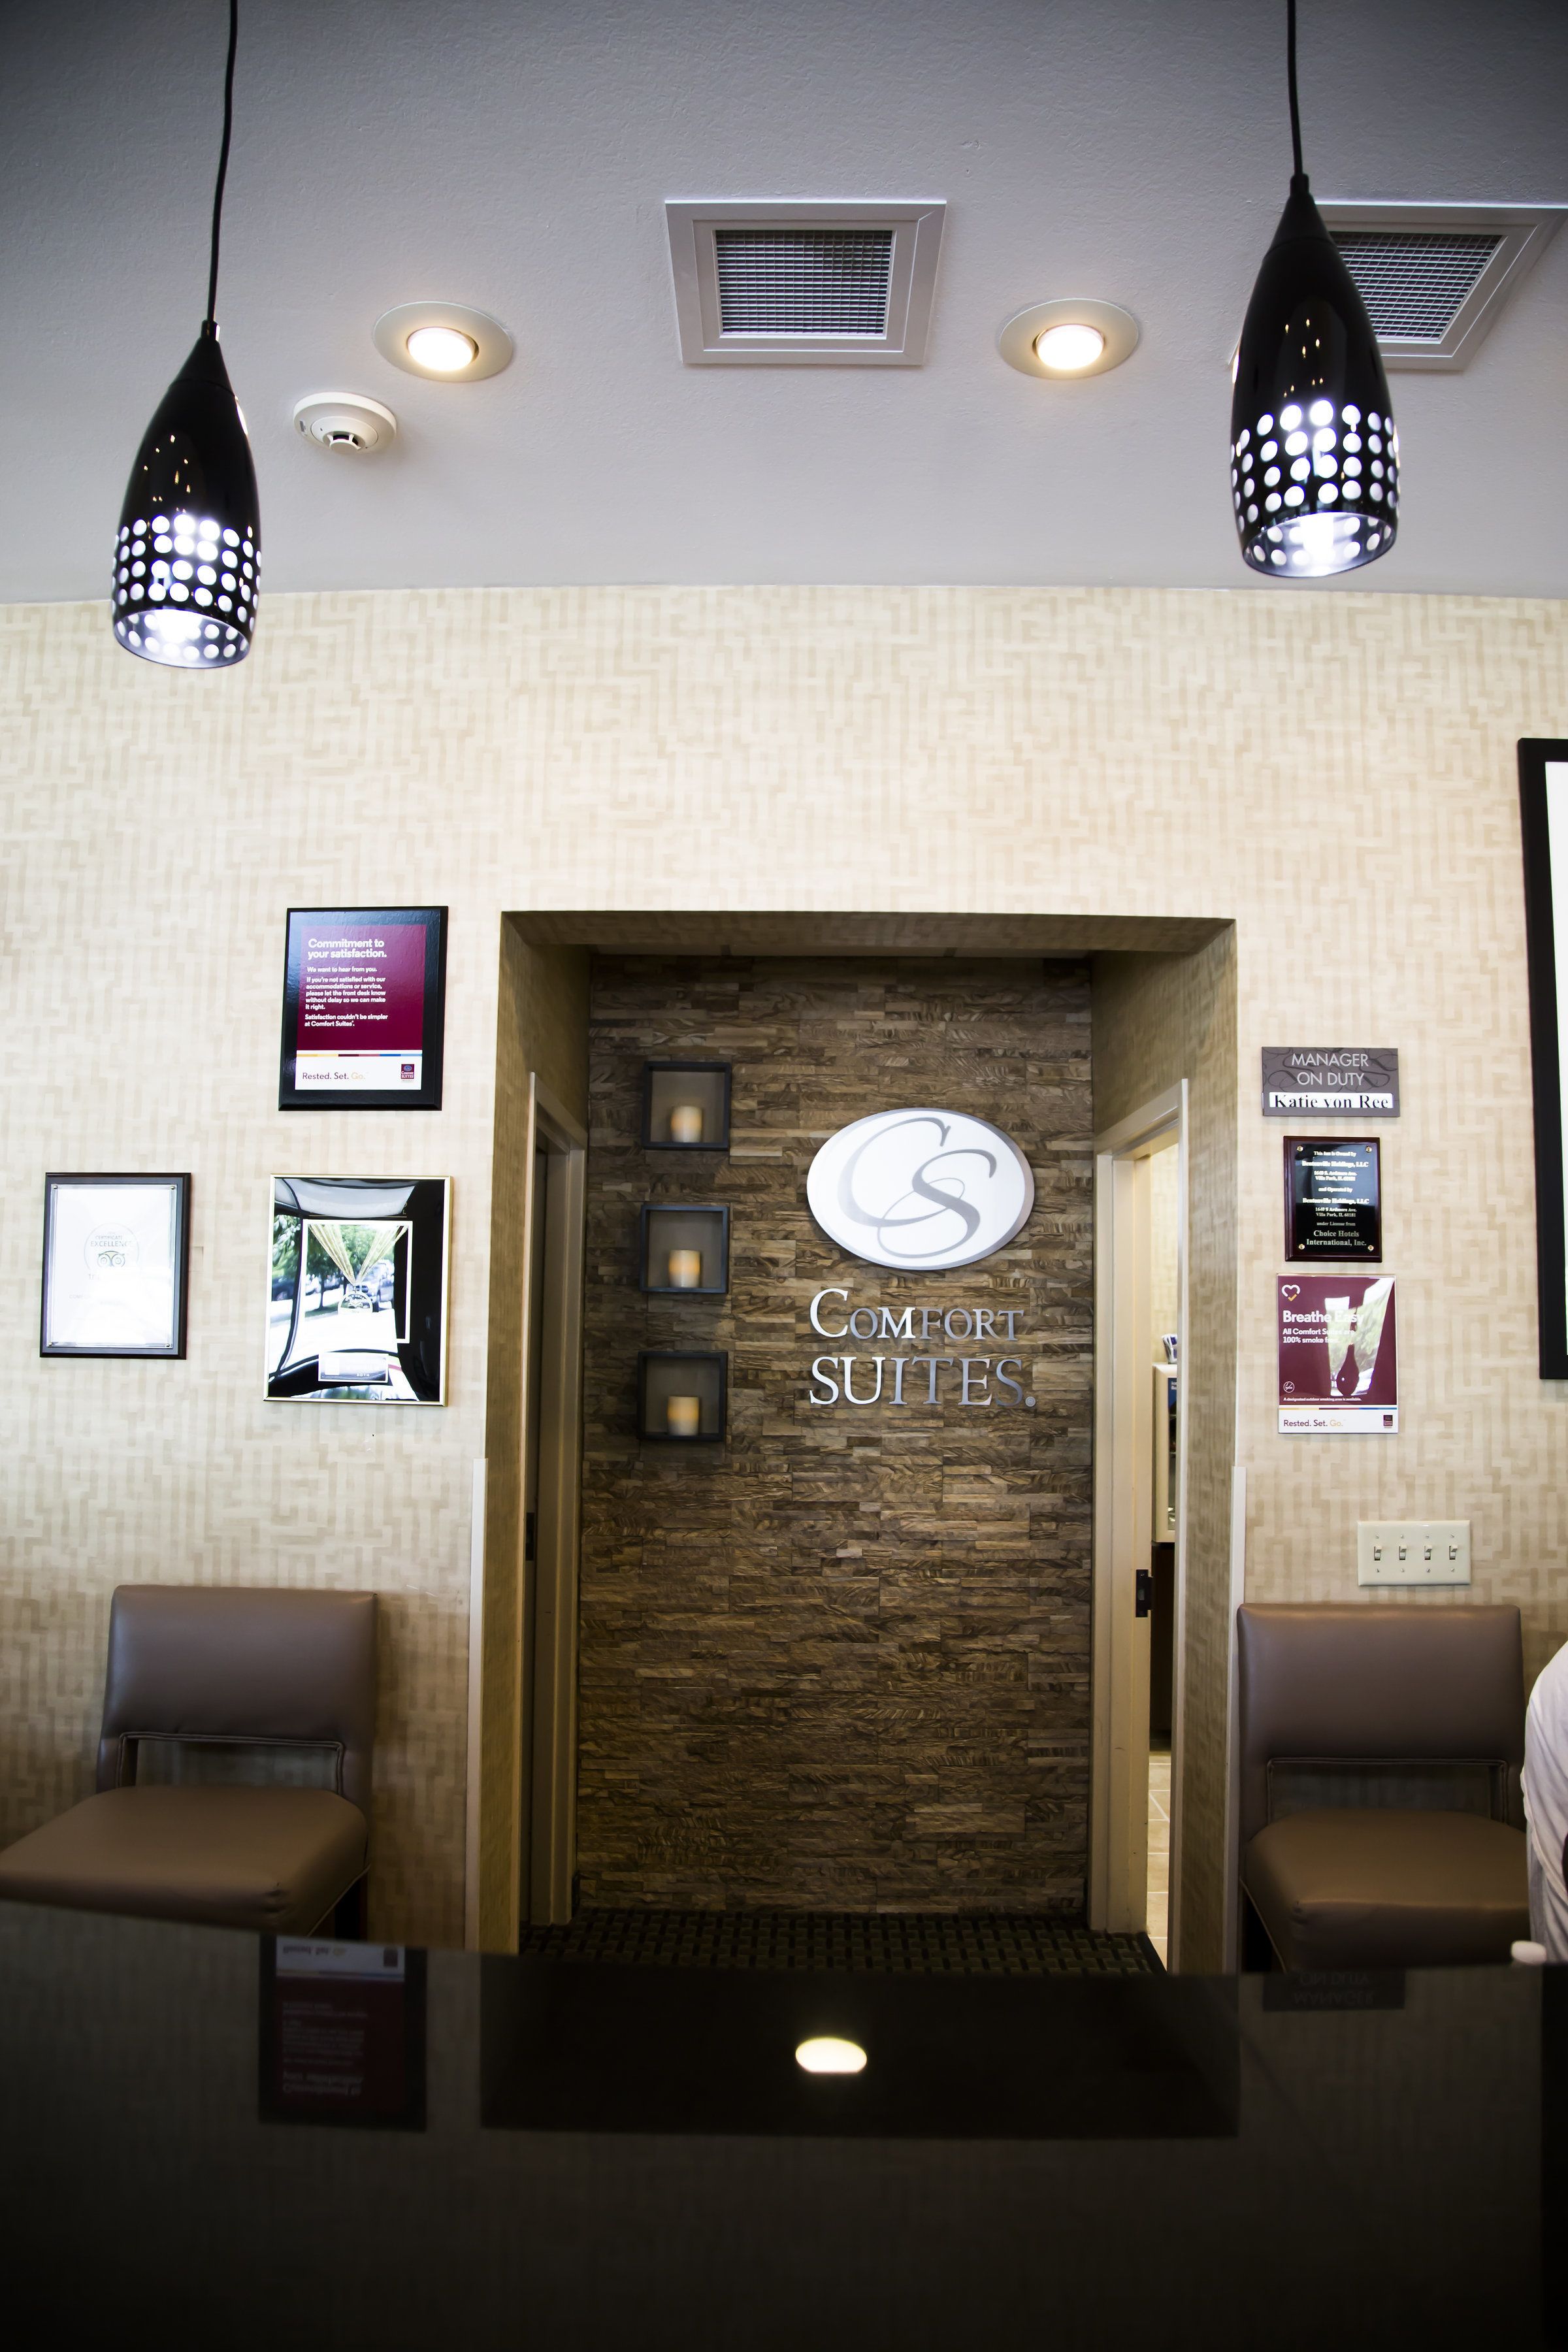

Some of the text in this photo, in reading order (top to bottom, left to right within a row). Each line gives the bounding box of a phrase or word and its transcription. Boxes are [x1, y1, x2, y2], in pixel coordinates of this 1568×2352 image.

[308, 938, 385, 947] Commitment to
[308, 949, 387, 960] your satisfaction.
[1292, 1053, 1369, 1067] MANAGER
[1297, 1071, 1365, 1086] ON DUTY
[1275, 1095, 1388, 1108] Katie von Ree
[838, 1117, 996, 1258] CS
[1283, 1310, 1364, 1325] Breathe Easy
